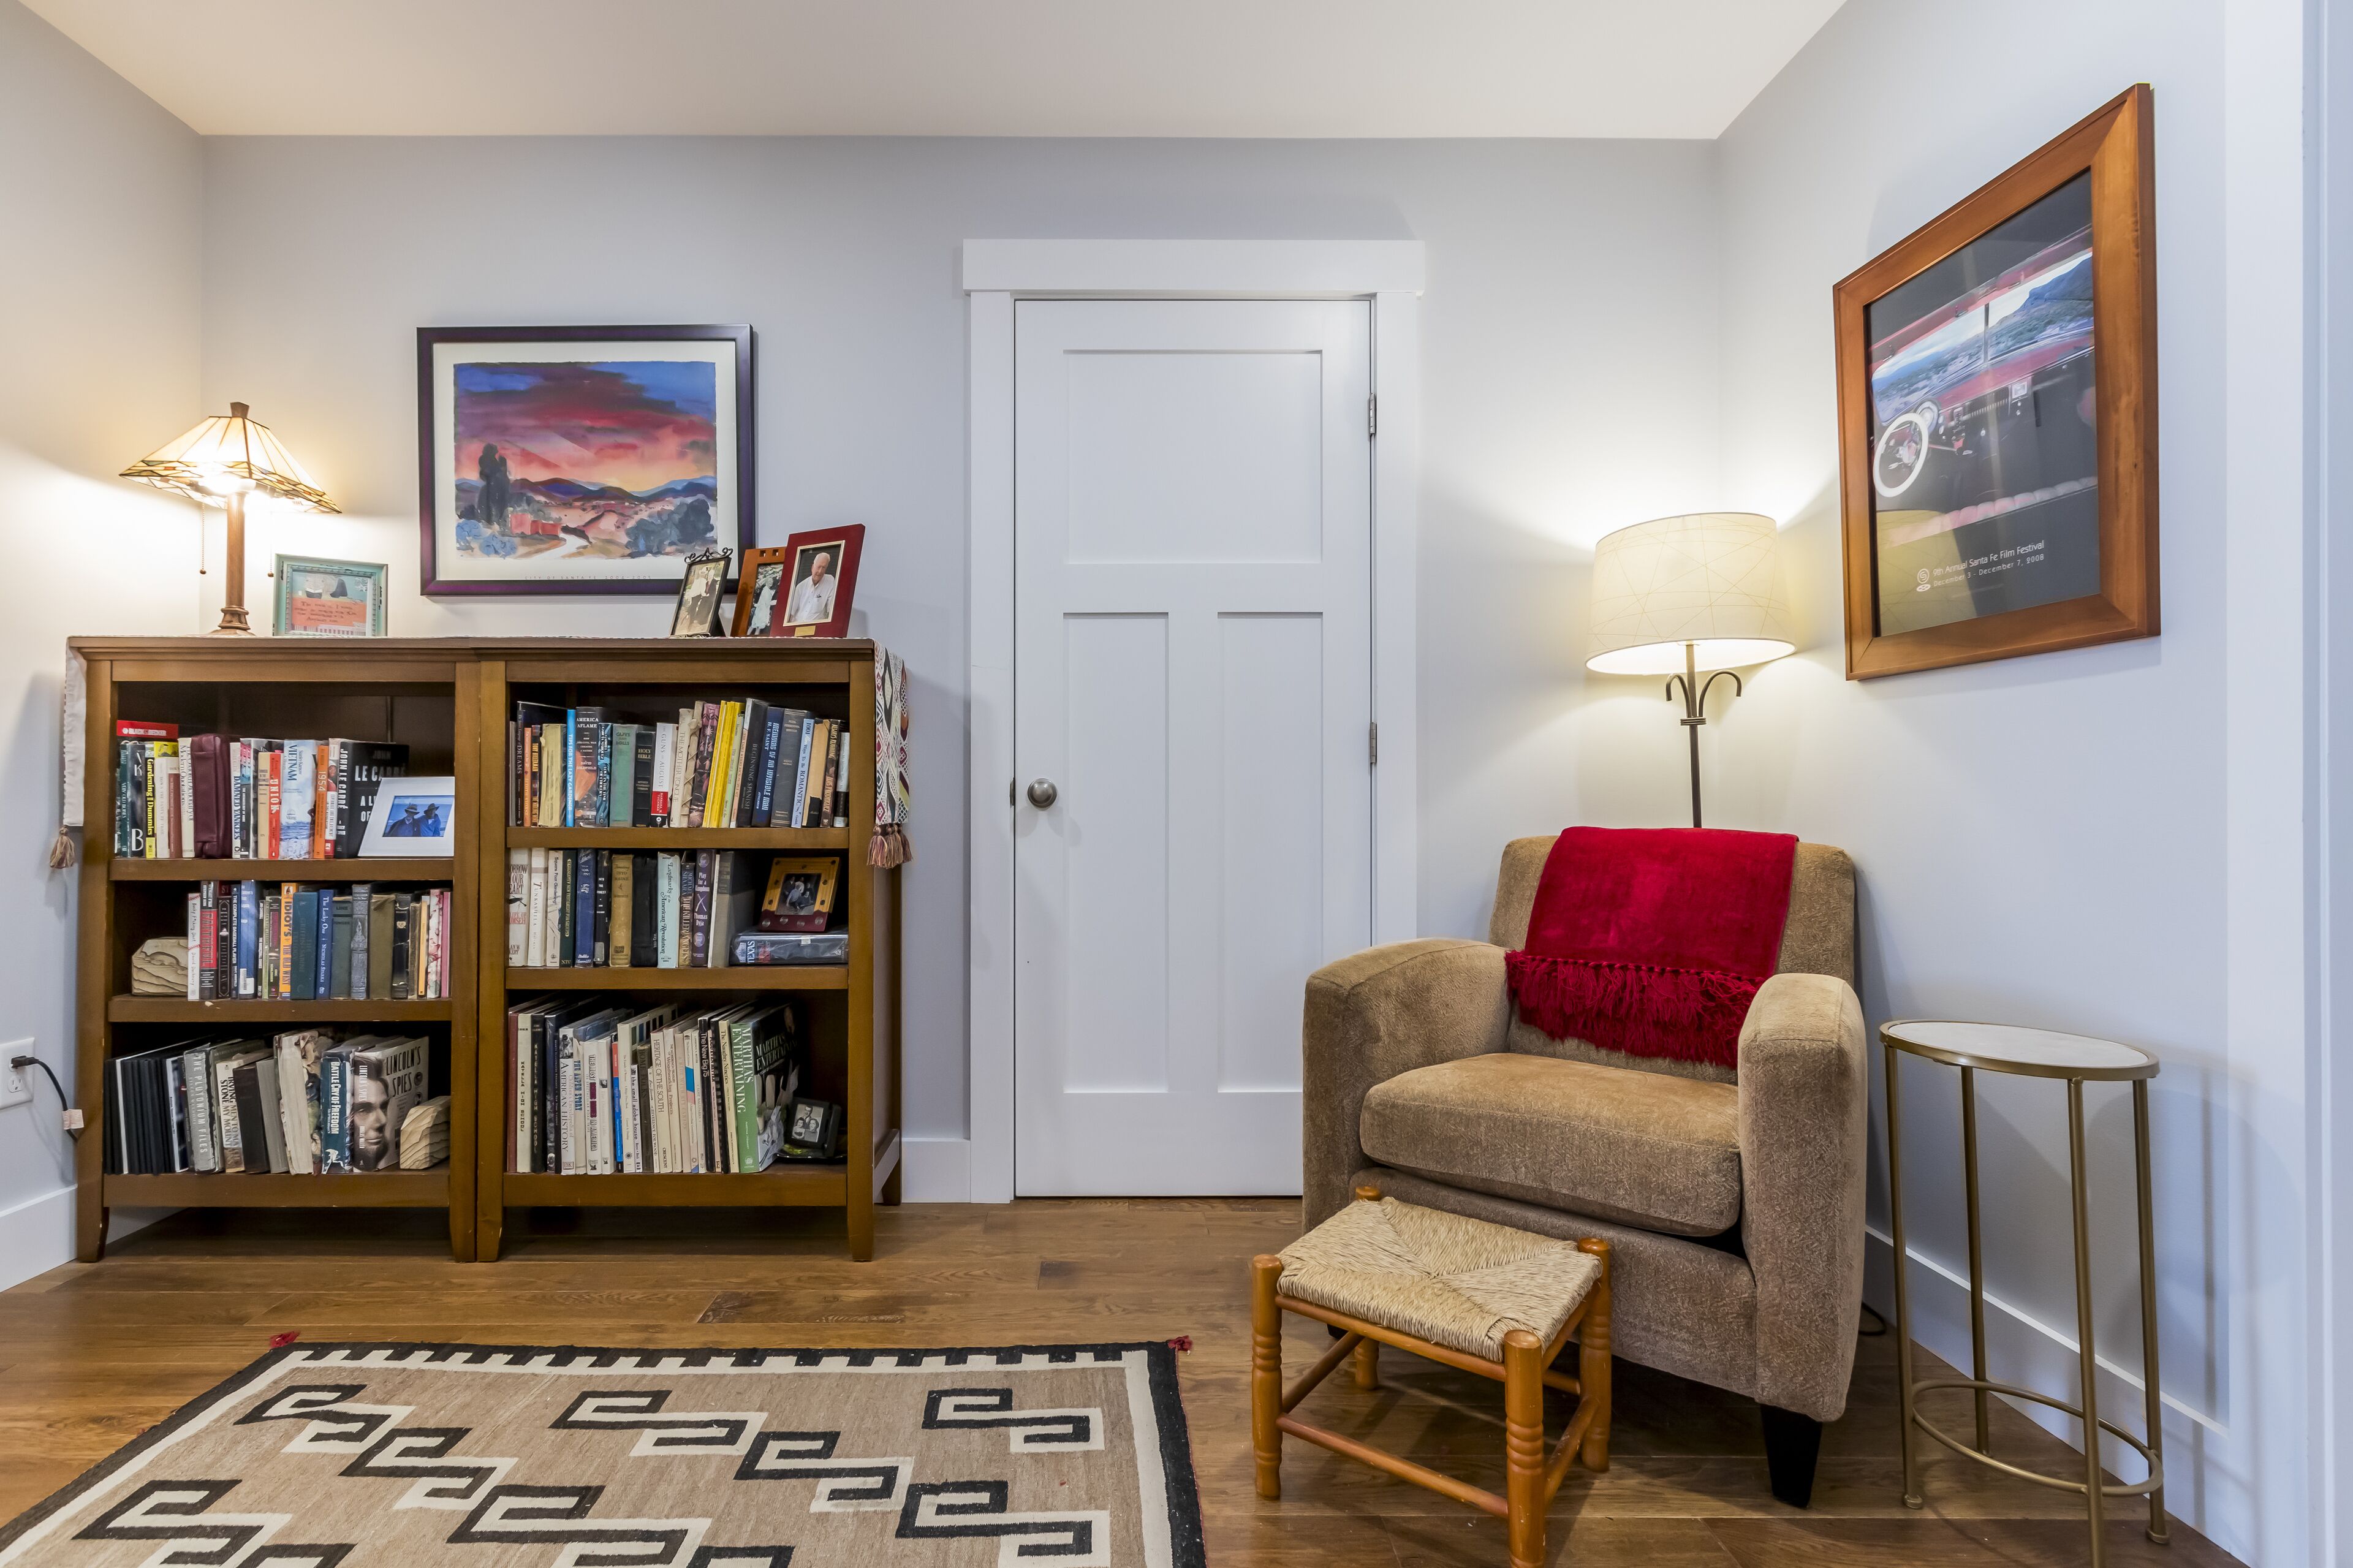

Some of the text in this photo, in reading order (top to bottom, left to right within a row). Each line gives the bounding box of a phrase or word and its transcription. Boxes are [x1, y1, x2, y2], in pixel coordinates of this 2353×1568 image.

[1933, 567, 1943, 577] 9th
[1945, 560, 1968, 574] Annual
[1969, 556, 1988, 567] Santa
[2000, 548, 2015, 559] Film
[2017, 540, 2044, 555] Festival
[1933, 574, 1965, 587] December
[1979, 561, 2014, 576] December
[2026, 554, 2044, 564] 2008
[287, 744, 297, 781] VIETNAM
[339, 749, 348, 770] JOHN
[828, 739, 837, 759] RUNNING
[146, 759, 154, 797] Gardening
[317, 771, 326, 792] 1954
[339, 773, 347, 781] LE
[355, 765, 368, 781] LE
[745, 744, 758, 809] BEGINNING SPANISH
[796, 770, 806, 806] ROMANTIC
[284, 901, 292, 937] IDIOT'S
[202, 913, 213, 964] FAITHFUL
[386, 1046, 422, 1075] LINCOLN'S
[653, 1039, 662, 1067] HERITAGE
[741, 1028, 754, 1083] MARTHA'S
[330, 1062, 340, 1083] BATTLE
[392, 1072, 412, 1097] SPIES
[560, 1062, 569, 1108] AMERICAN
[656, 1069, 662, 1079] OF
[732, 1028, 745, 1113] ENTERTAINING
[228, 1077, 237, 1103] IRVING
[331, 1083, 341, 1096] CRY
[193, 1056, 208, 1153] THE PLUTONIUM FILES
[223, 1105, 231, 1116] MY
[331, 1105, 341, 1134] FREEDOM
